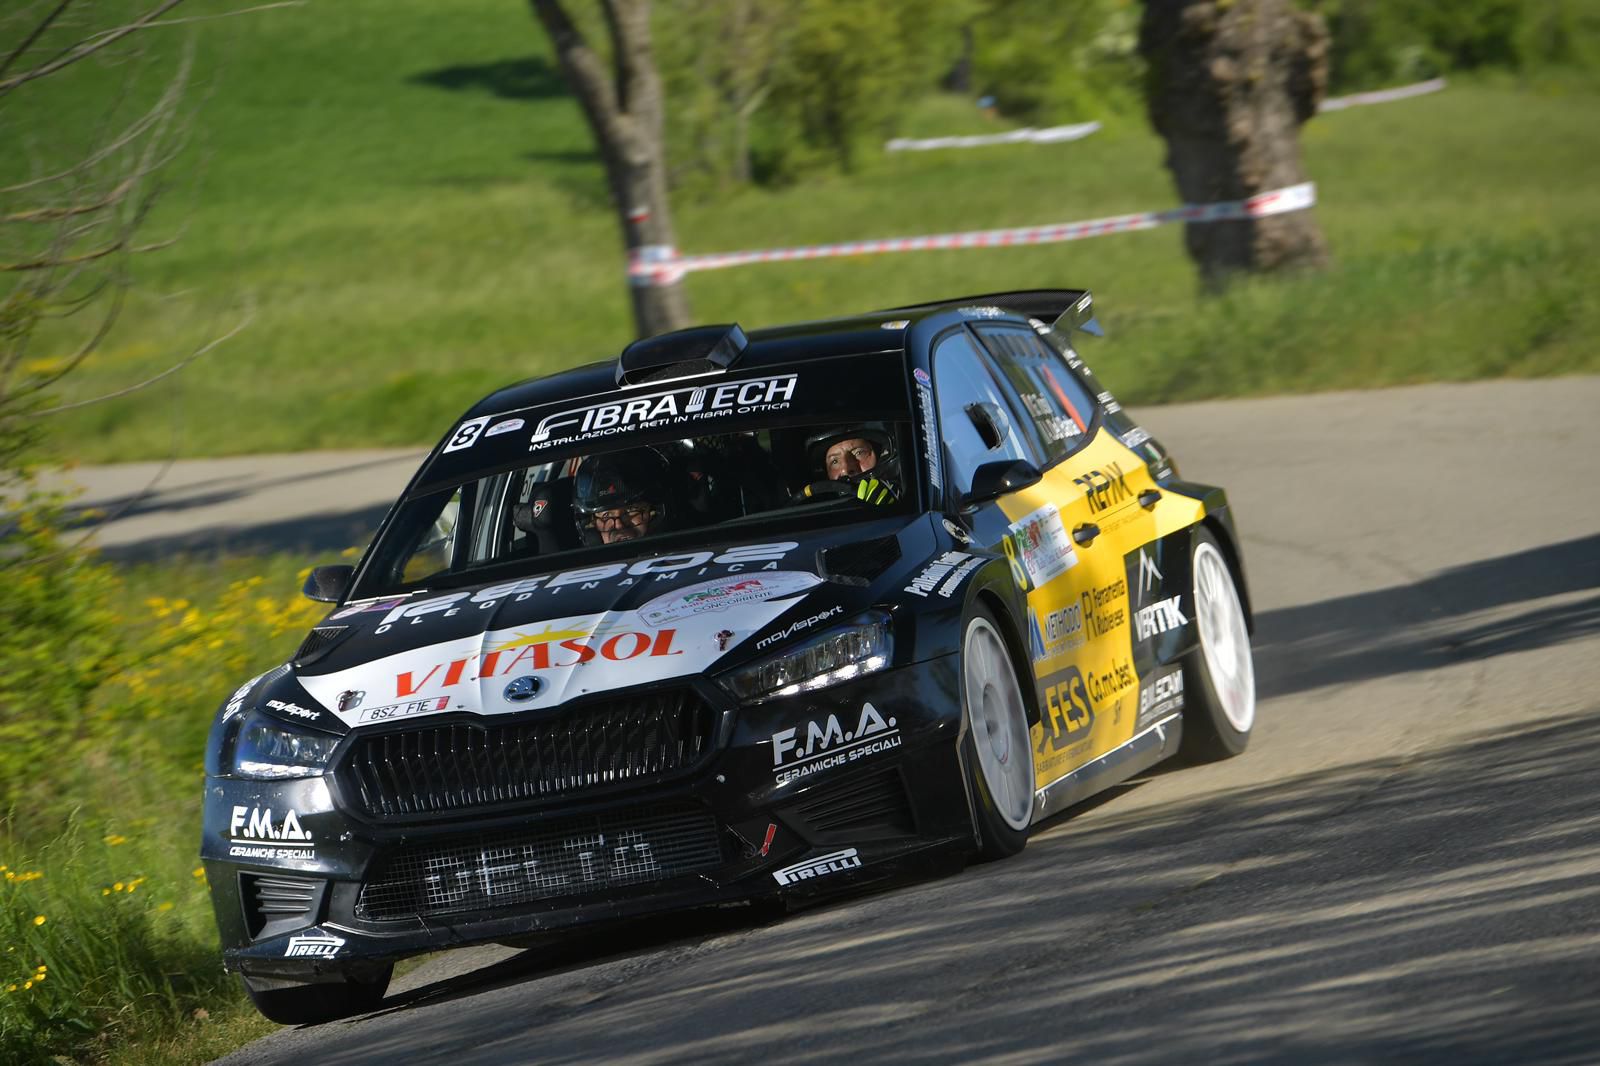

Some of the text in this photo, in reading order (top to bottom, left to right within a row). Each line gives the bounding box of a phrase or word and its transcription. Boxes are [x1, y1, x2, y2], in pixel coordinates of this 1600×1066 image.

[529, 423, 636, 452] INSTALLAZIONE
[639, 418, 671, 430] RETI
[673, 414, 691, 425] IN
[693, 408, 734, 421] FIBRA
[737, 401, 790, 415] OTTICA
[531, 373, 798, 442] FIBRATECH
[452, 423, 482, 447] 8
[1003, 534, 1028, 591] 8
[375, 562, 778, 635] OLEODINAMICA
[693, 592, 773, 613] CONCORRENTE
[396, 629, 684, 698] VITASOL
[370, 705, 398, 720] 8SZ
[1045, 677, 1090, 738] FES
[772, 702, 897, 766] F.M.A.
[775, 736, 901, 785] CERAMICHE SPECIALI
[230, 806, 312, 841] F.M.A.
[229, 846, 314, 860] CERAMICHE SPECIALI
[772, 848, 863, 886] PIRELLI
[284, 936, 345, 958] PIRELLI
